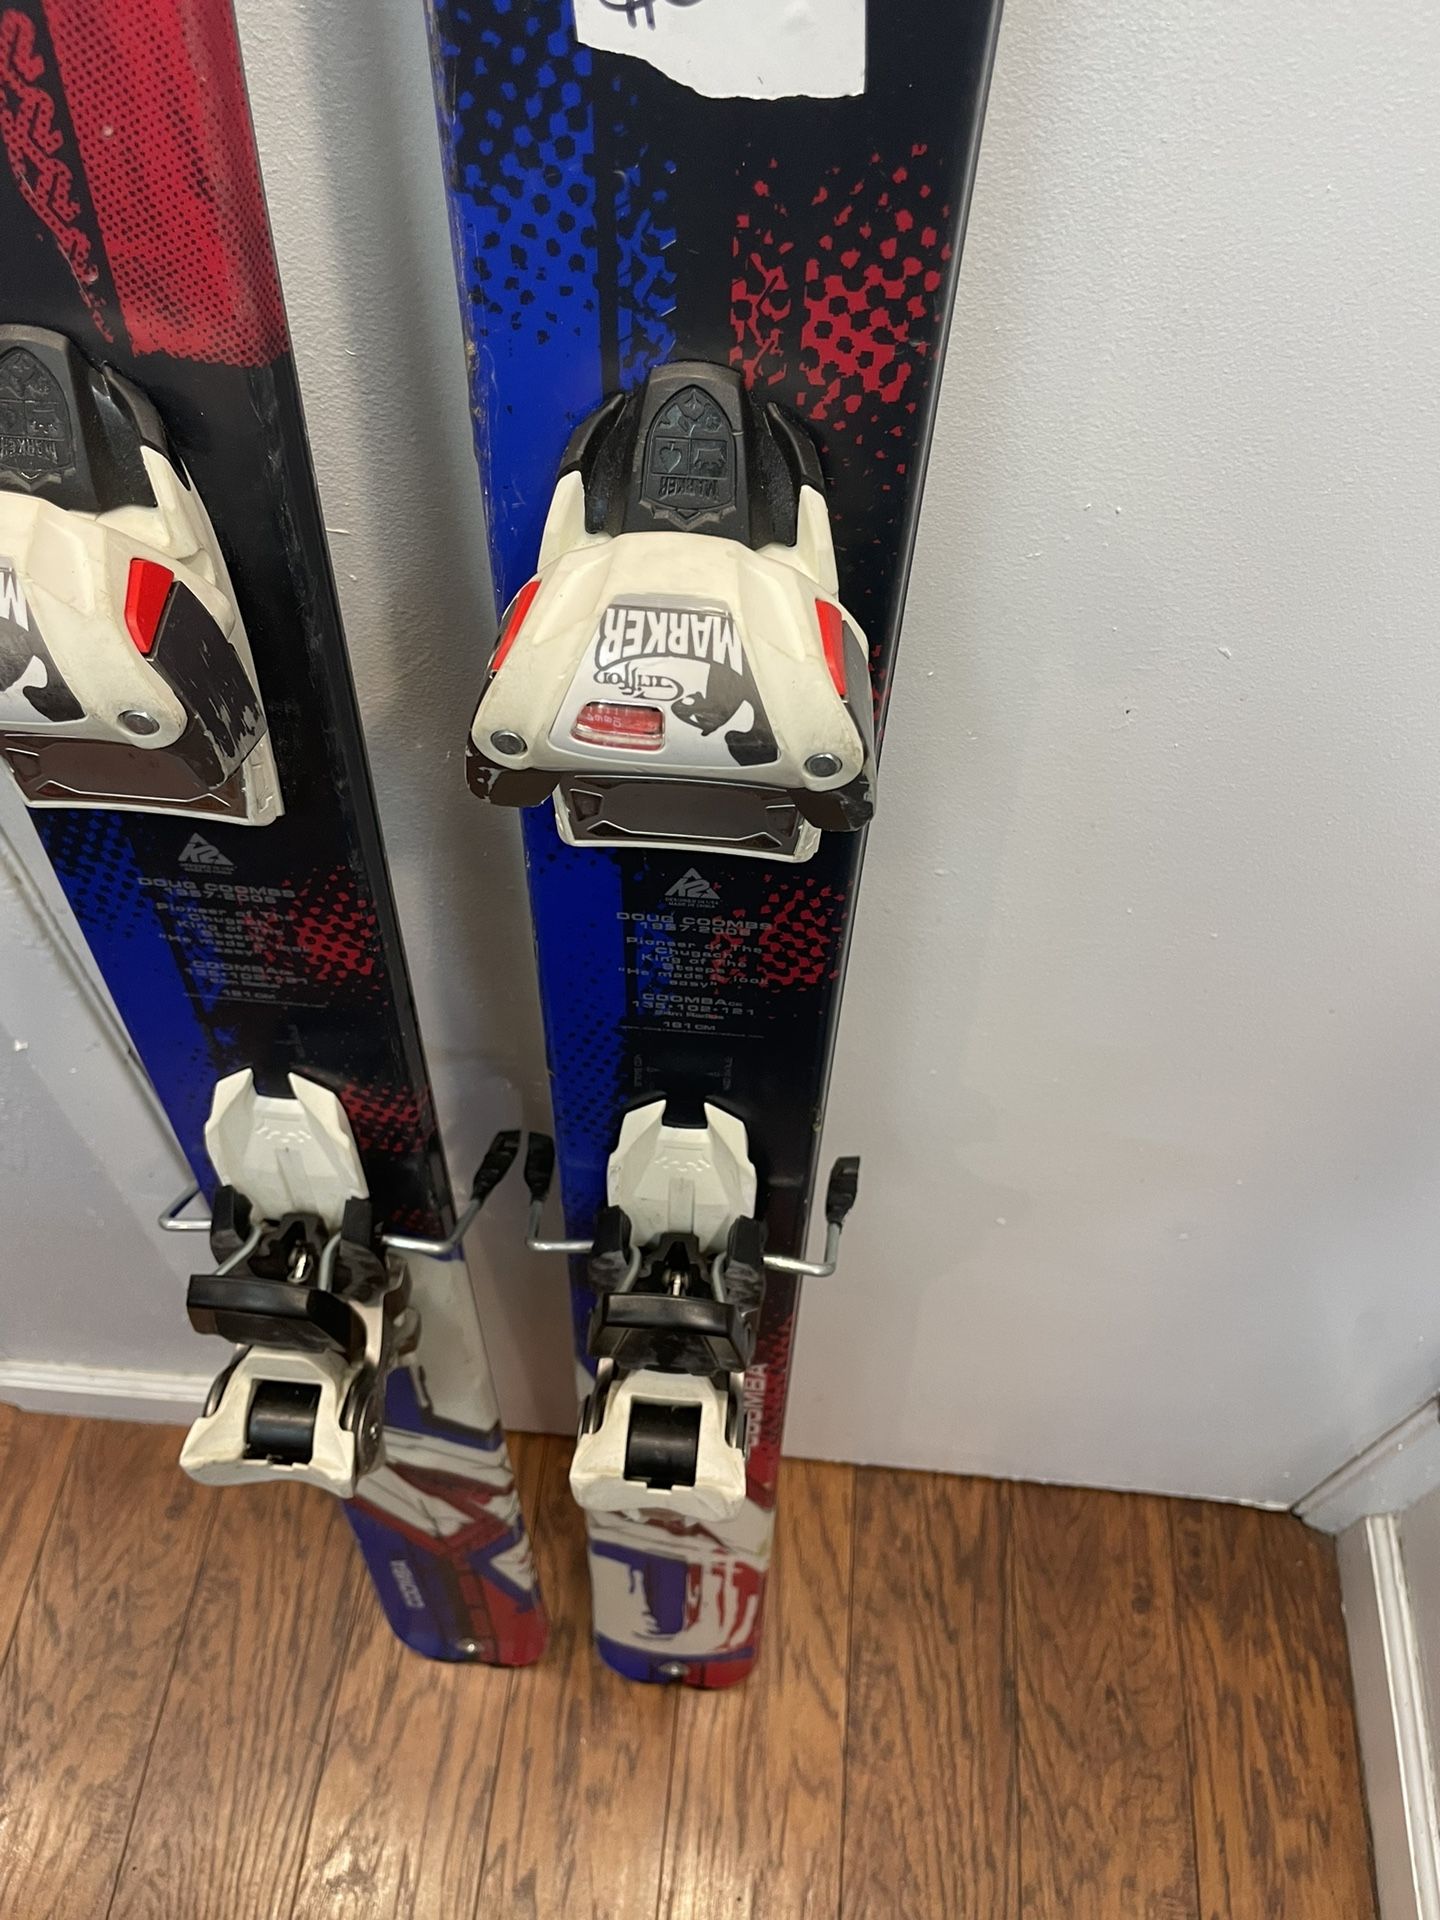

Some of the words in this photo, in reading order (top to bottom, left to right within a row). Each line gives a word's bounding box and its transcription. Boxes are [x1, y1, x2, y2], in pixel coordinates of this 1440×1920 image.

[599, 607, 743, 677] MARKER
[593, 661, 684, 701] Griffon
[178, 840, 227, 865] K2
[137, 877, 197, 889] DOUG
[204, 883, 295, 898] COOMBS
[665, 875, 715, 899] K2
[616, 911, 674, 923] DOUG
[682, 916, 773, 930] COOMBS
[626, 936, 696, 949] Pioneer
[655, 946, 733, 959] Chugach
[641, 953, 681, 964] King
[658, 971, 704, 980] made
